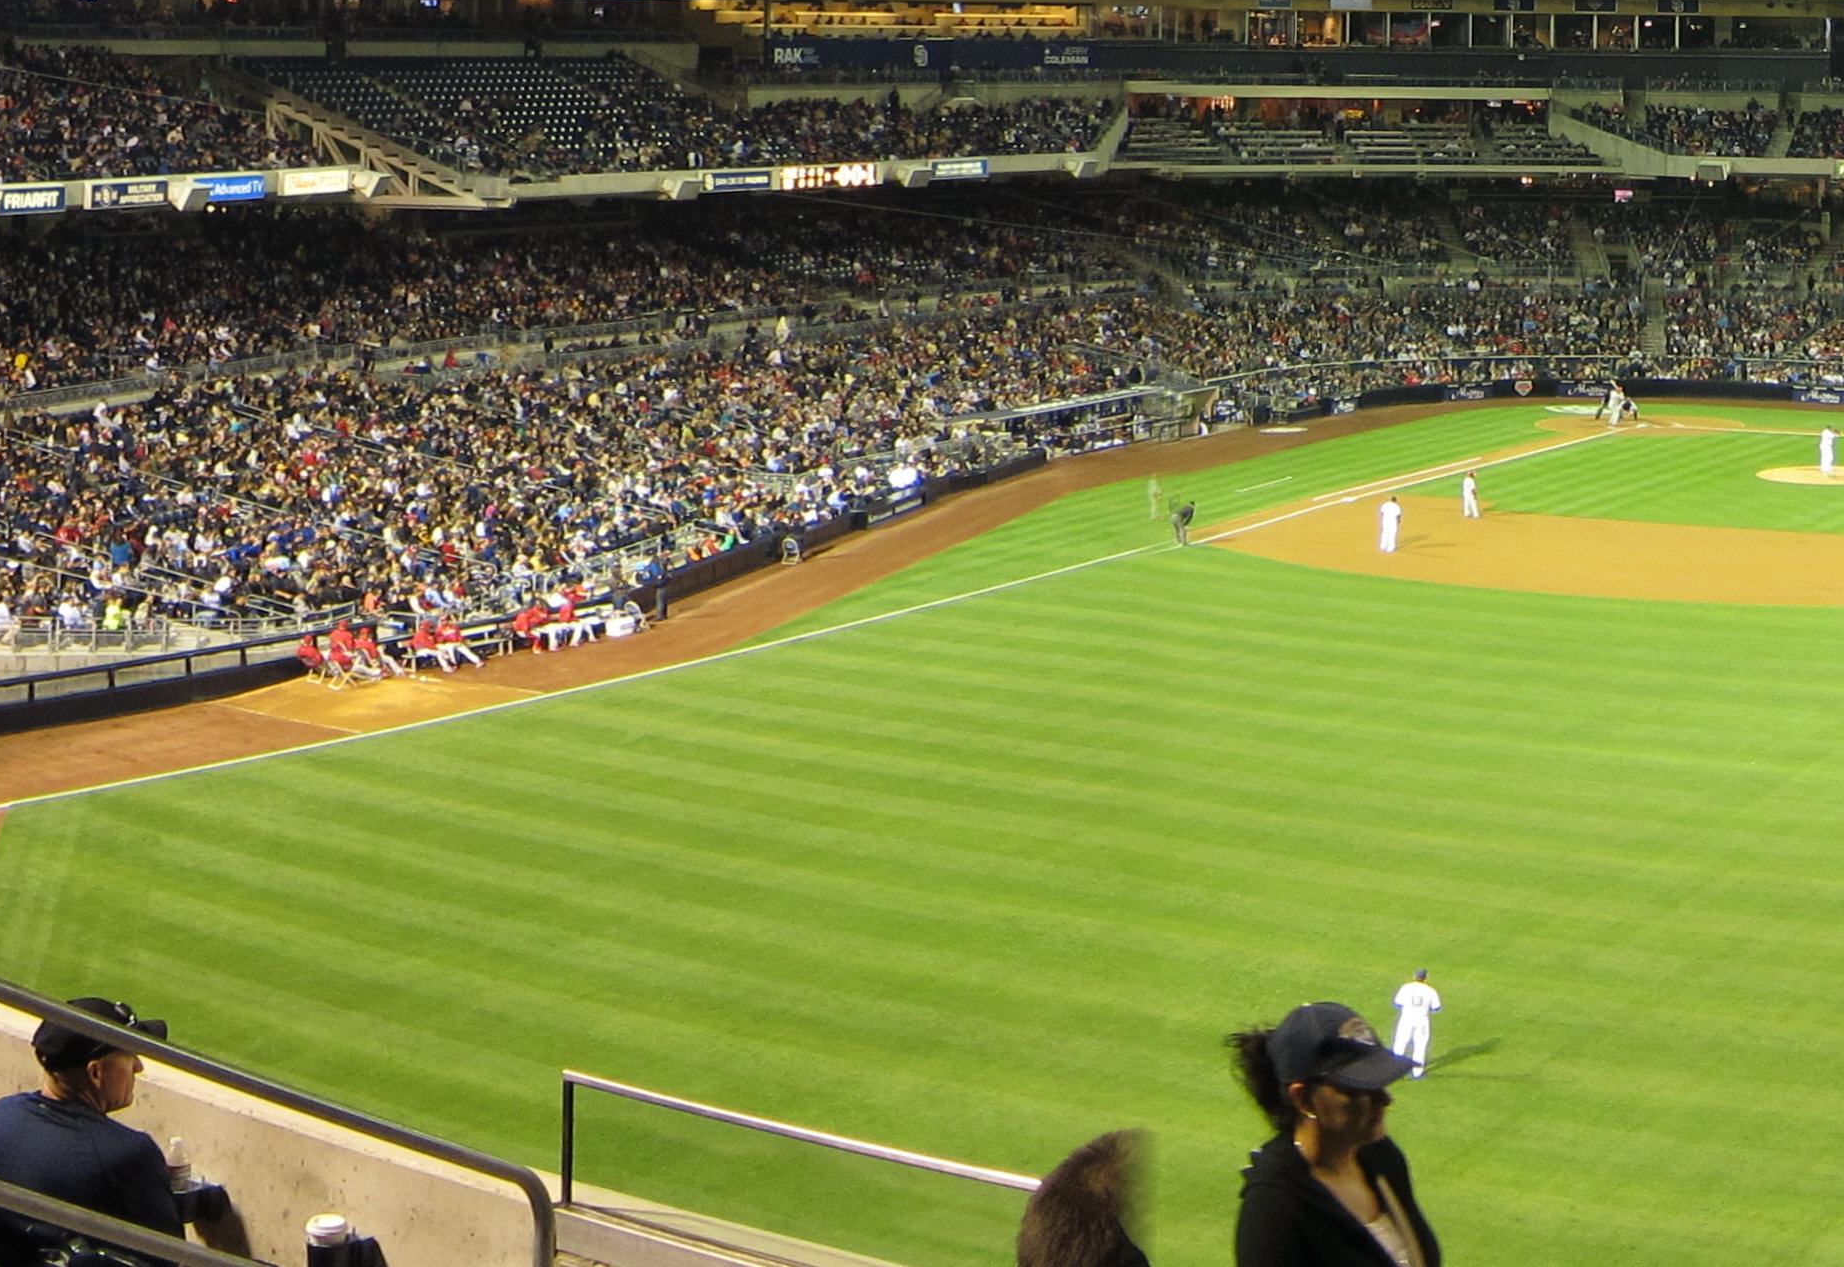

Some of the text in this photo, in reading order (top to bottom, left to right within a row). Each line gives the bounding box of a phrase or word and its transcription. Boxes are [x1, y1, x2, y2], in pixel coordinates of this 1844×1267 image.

[774, 48, 804, 64] RAK
[1044, 55, 1089, 65] COLEMAN
[213, 179, 251, 196] Advanced
[252, 178, 265, 193] TV
[3, 191, 59, 210] FRIARFIT
